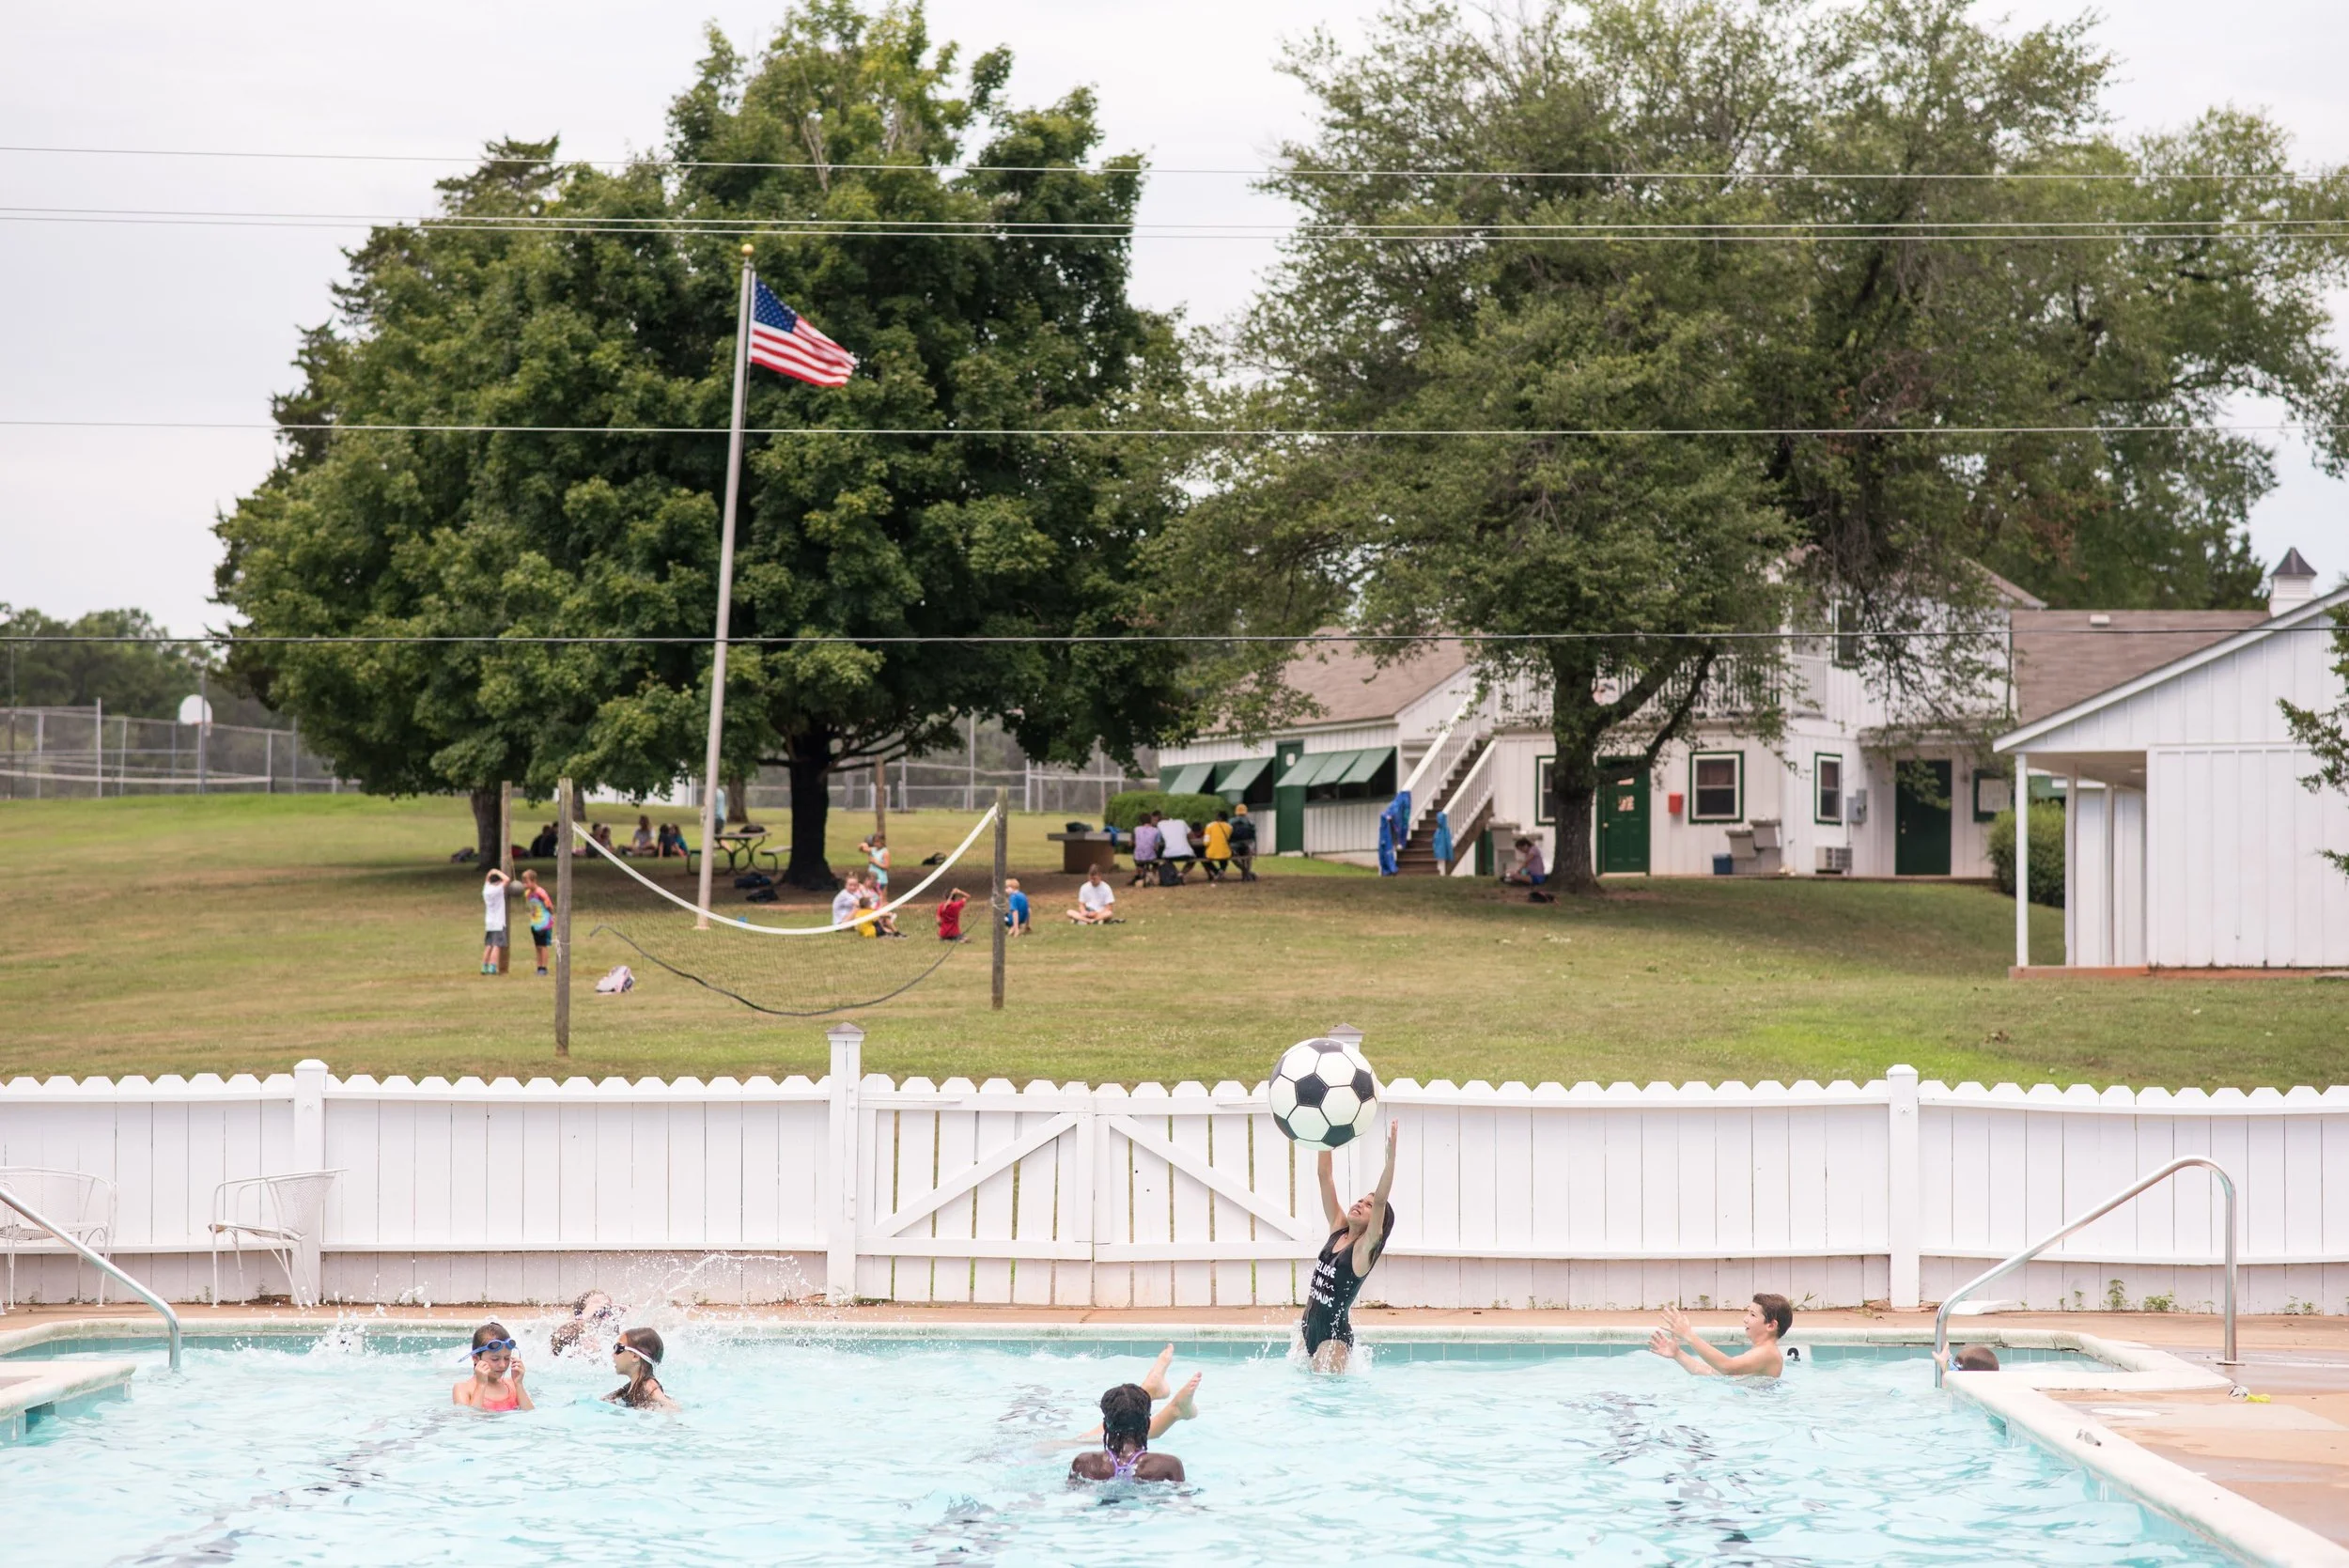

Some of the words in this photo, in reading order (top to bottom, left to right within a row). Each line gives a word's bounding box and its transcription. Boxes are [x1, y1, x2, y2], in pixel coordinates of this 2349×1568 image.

[1316, 1260, 1336, 1278] ELIEVE
[1316, 1276, 1324, 1287] IN
[1310, 1287, 1334, 1307] ERMAIDS
